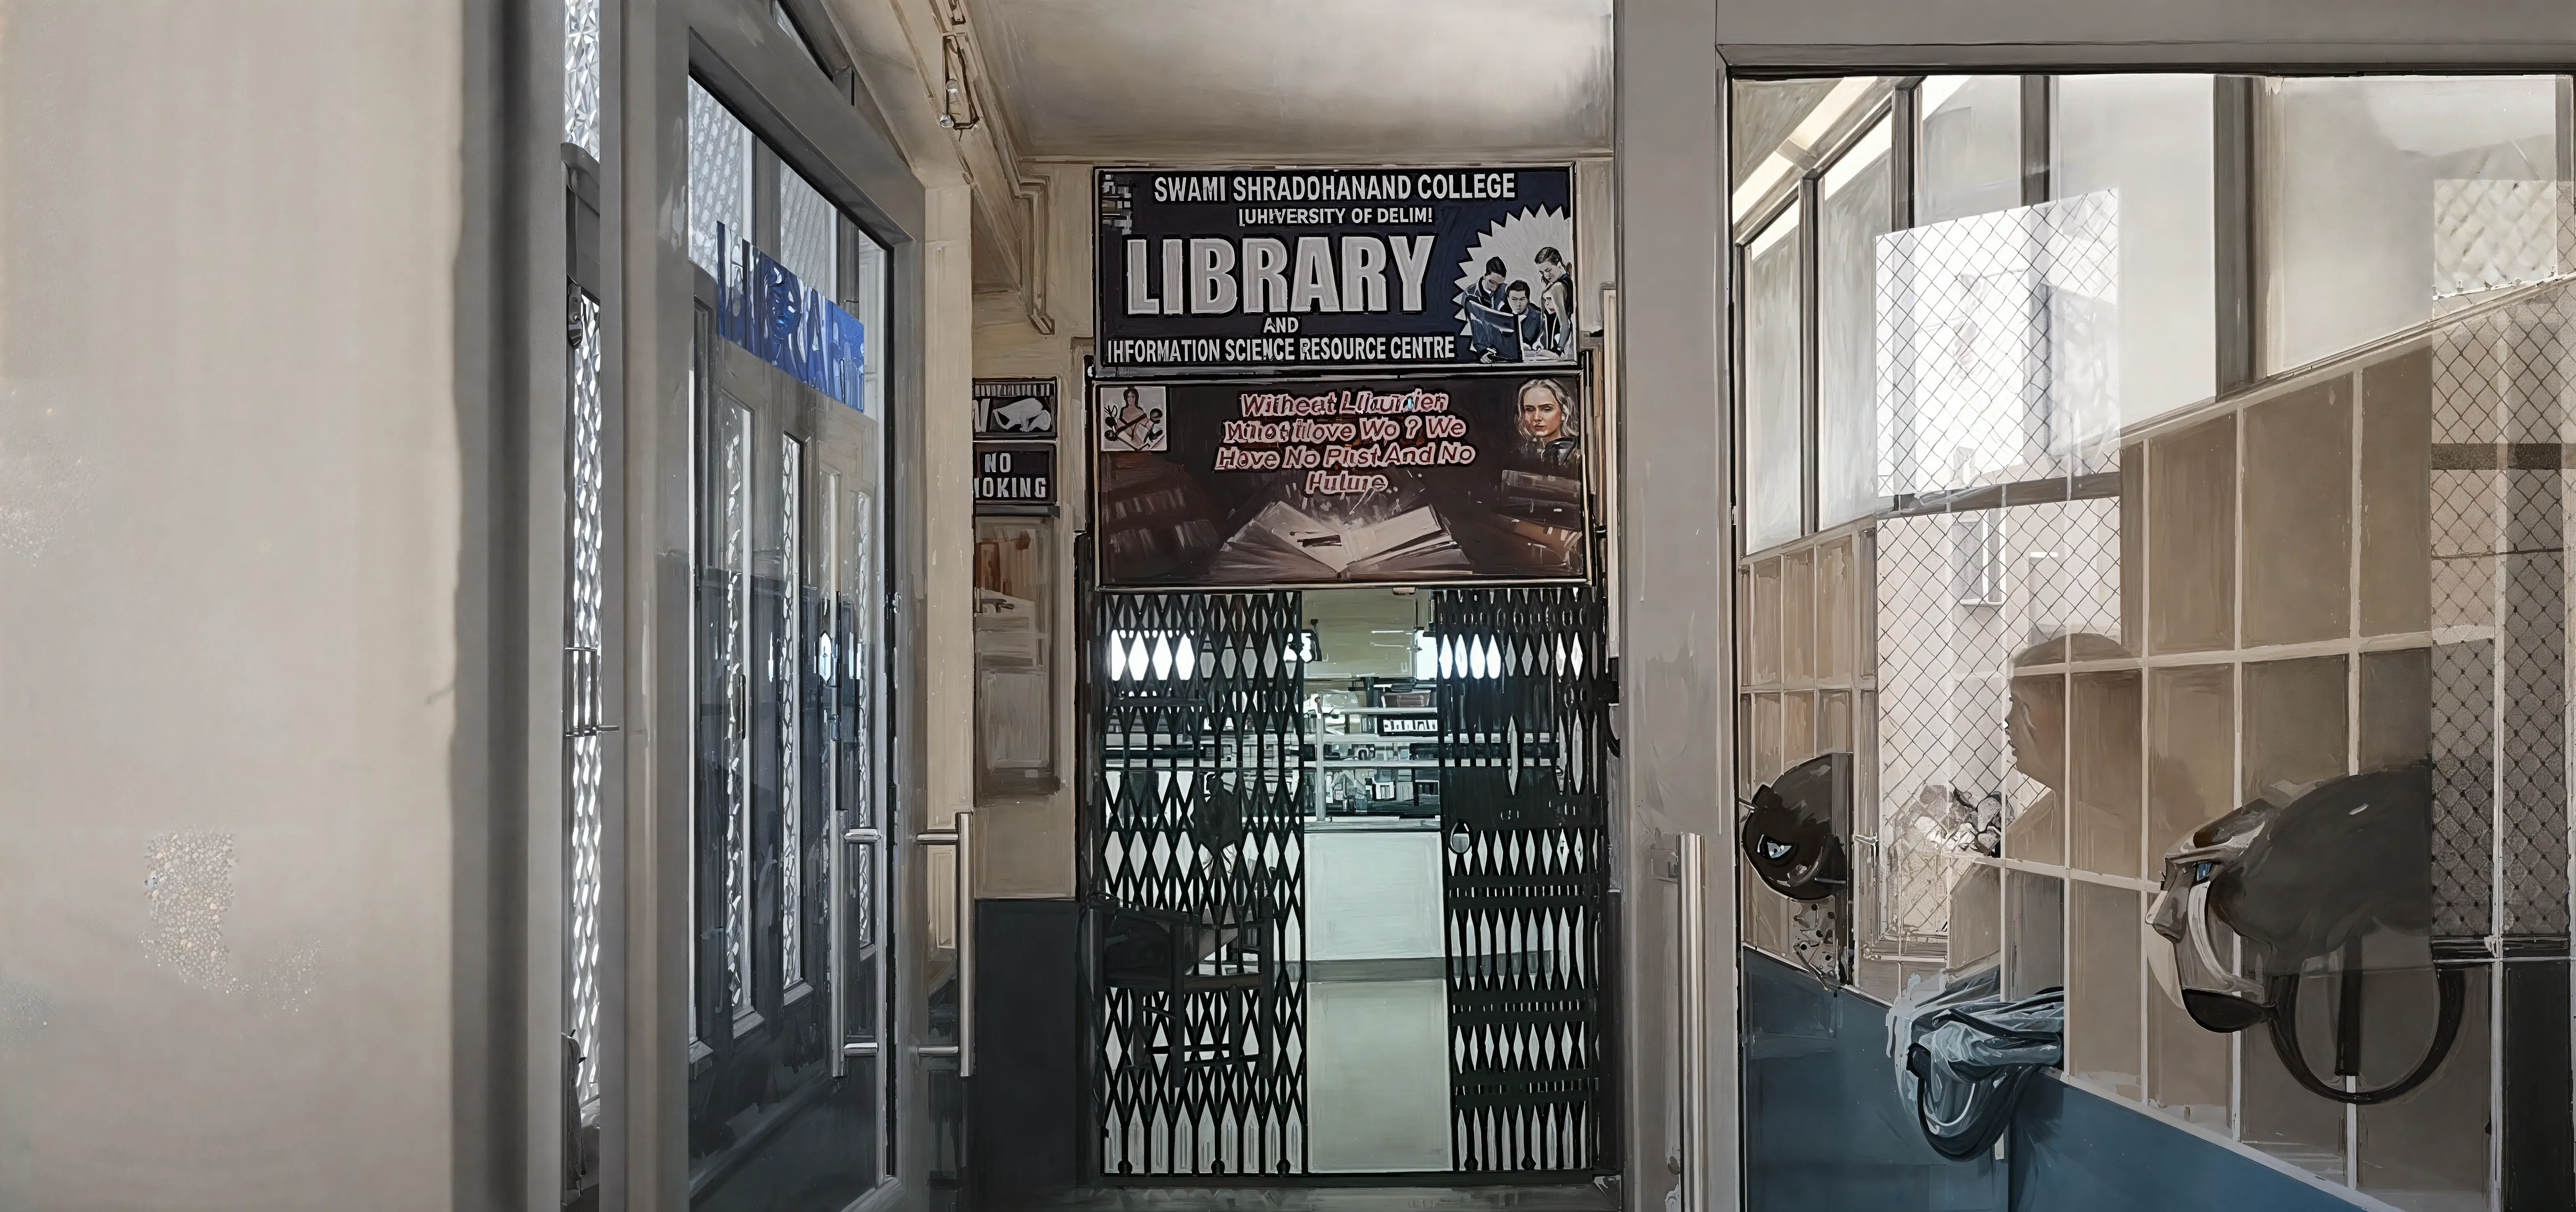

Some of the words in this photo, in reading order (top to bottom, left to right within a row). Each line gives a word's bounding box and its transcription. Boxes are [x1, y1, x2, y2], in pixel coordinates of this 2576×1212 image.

[1154, 176, 1226, 202] SWAMI
[1418, 173, 1515, 199] COLLEGE
[1352, 208, 1372, 223] OF
[1127, 236, 1435, 314] LIBRARY
[1263, 317, 1299, 333] AND
[1225, 338, 1294, 361] SCIENCE
[1300, 337, 1386, 360] RESOURCE
[1391, 336, 1455, 359] CENTRE
[1404, 415, 1422, 439] ?
[1425, 415, 1466, 438] We
[985, 452, 1011, 473] NO
[1282, 445, 1320, 469] No
[1383, 442, 1436, 467] And
[1438, 441, 1476, 465] No
